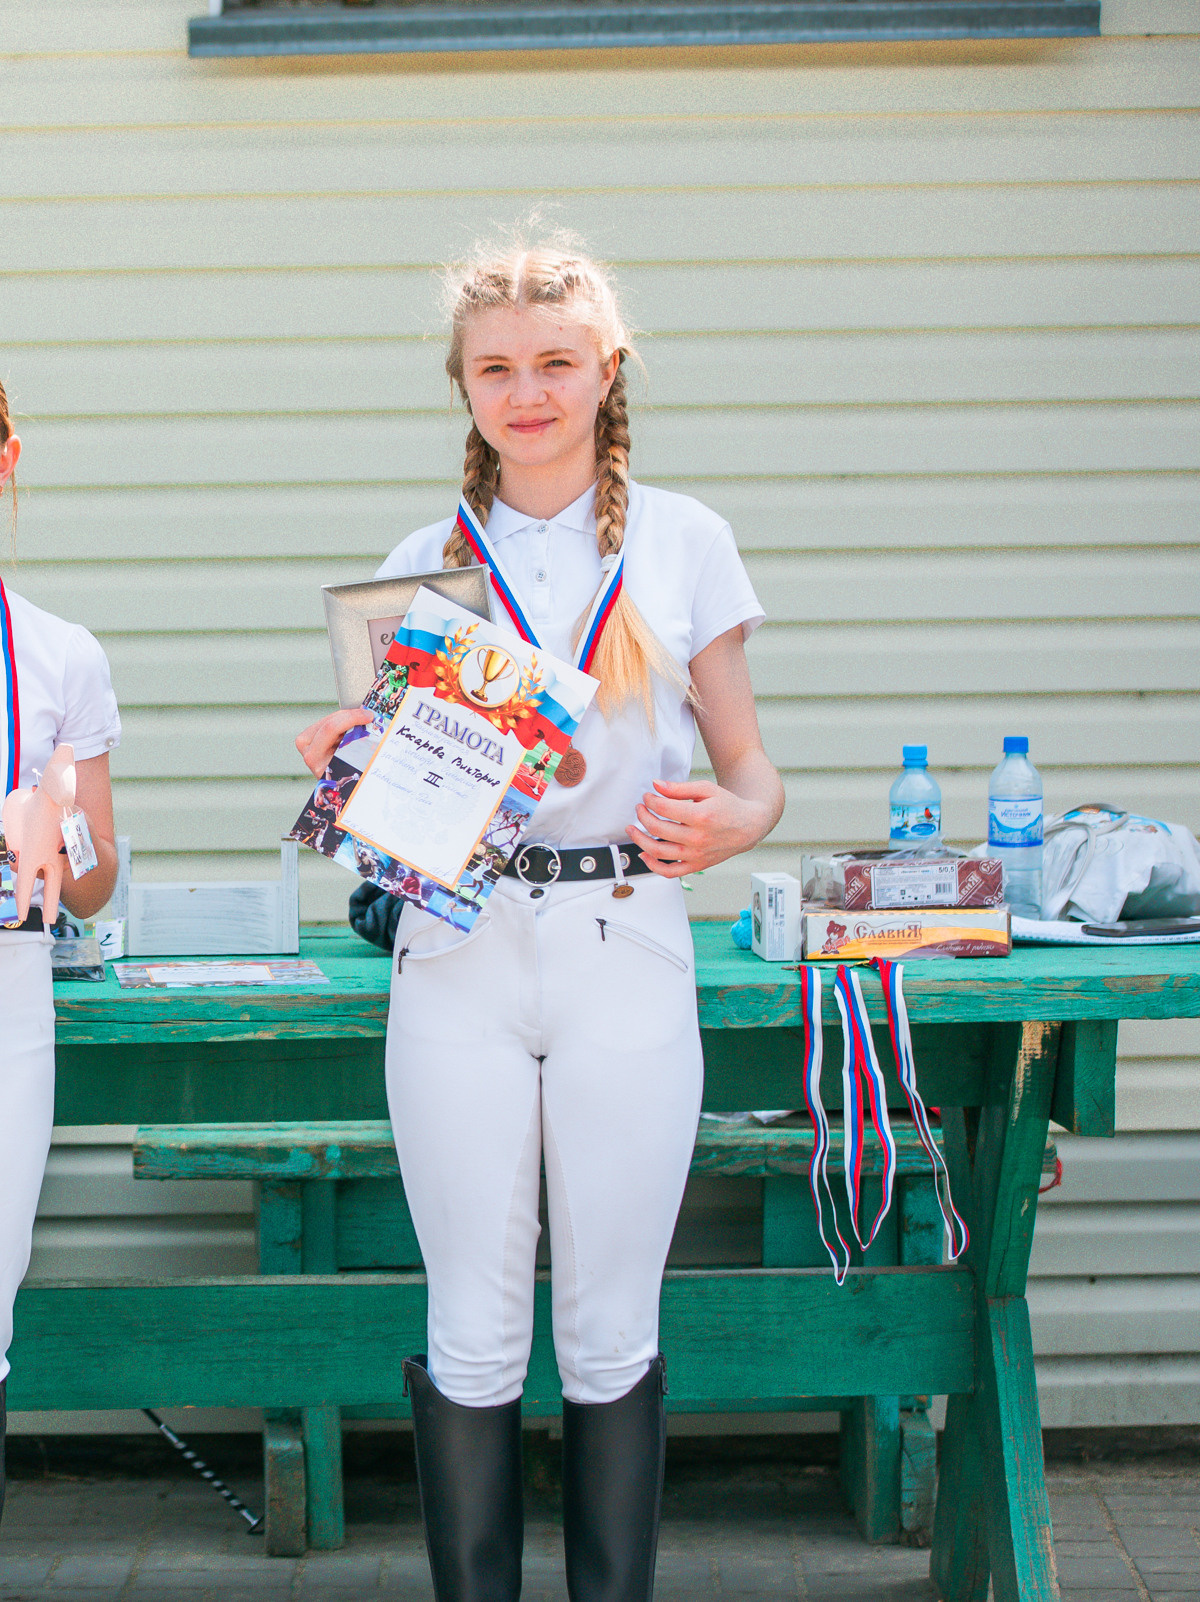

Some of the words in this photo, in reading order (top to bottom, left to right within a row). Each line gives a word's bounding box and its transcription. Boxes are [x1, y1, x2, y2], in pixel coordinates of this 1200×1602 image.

[411, 700, 506, 766] ГРАМОТА
[395, 724, 445, 760] Косарева
[451, 756, 501, 788] Виктория
[423, 770, 444, 788] III
[938, 866, 955, 874] 5/0,5
